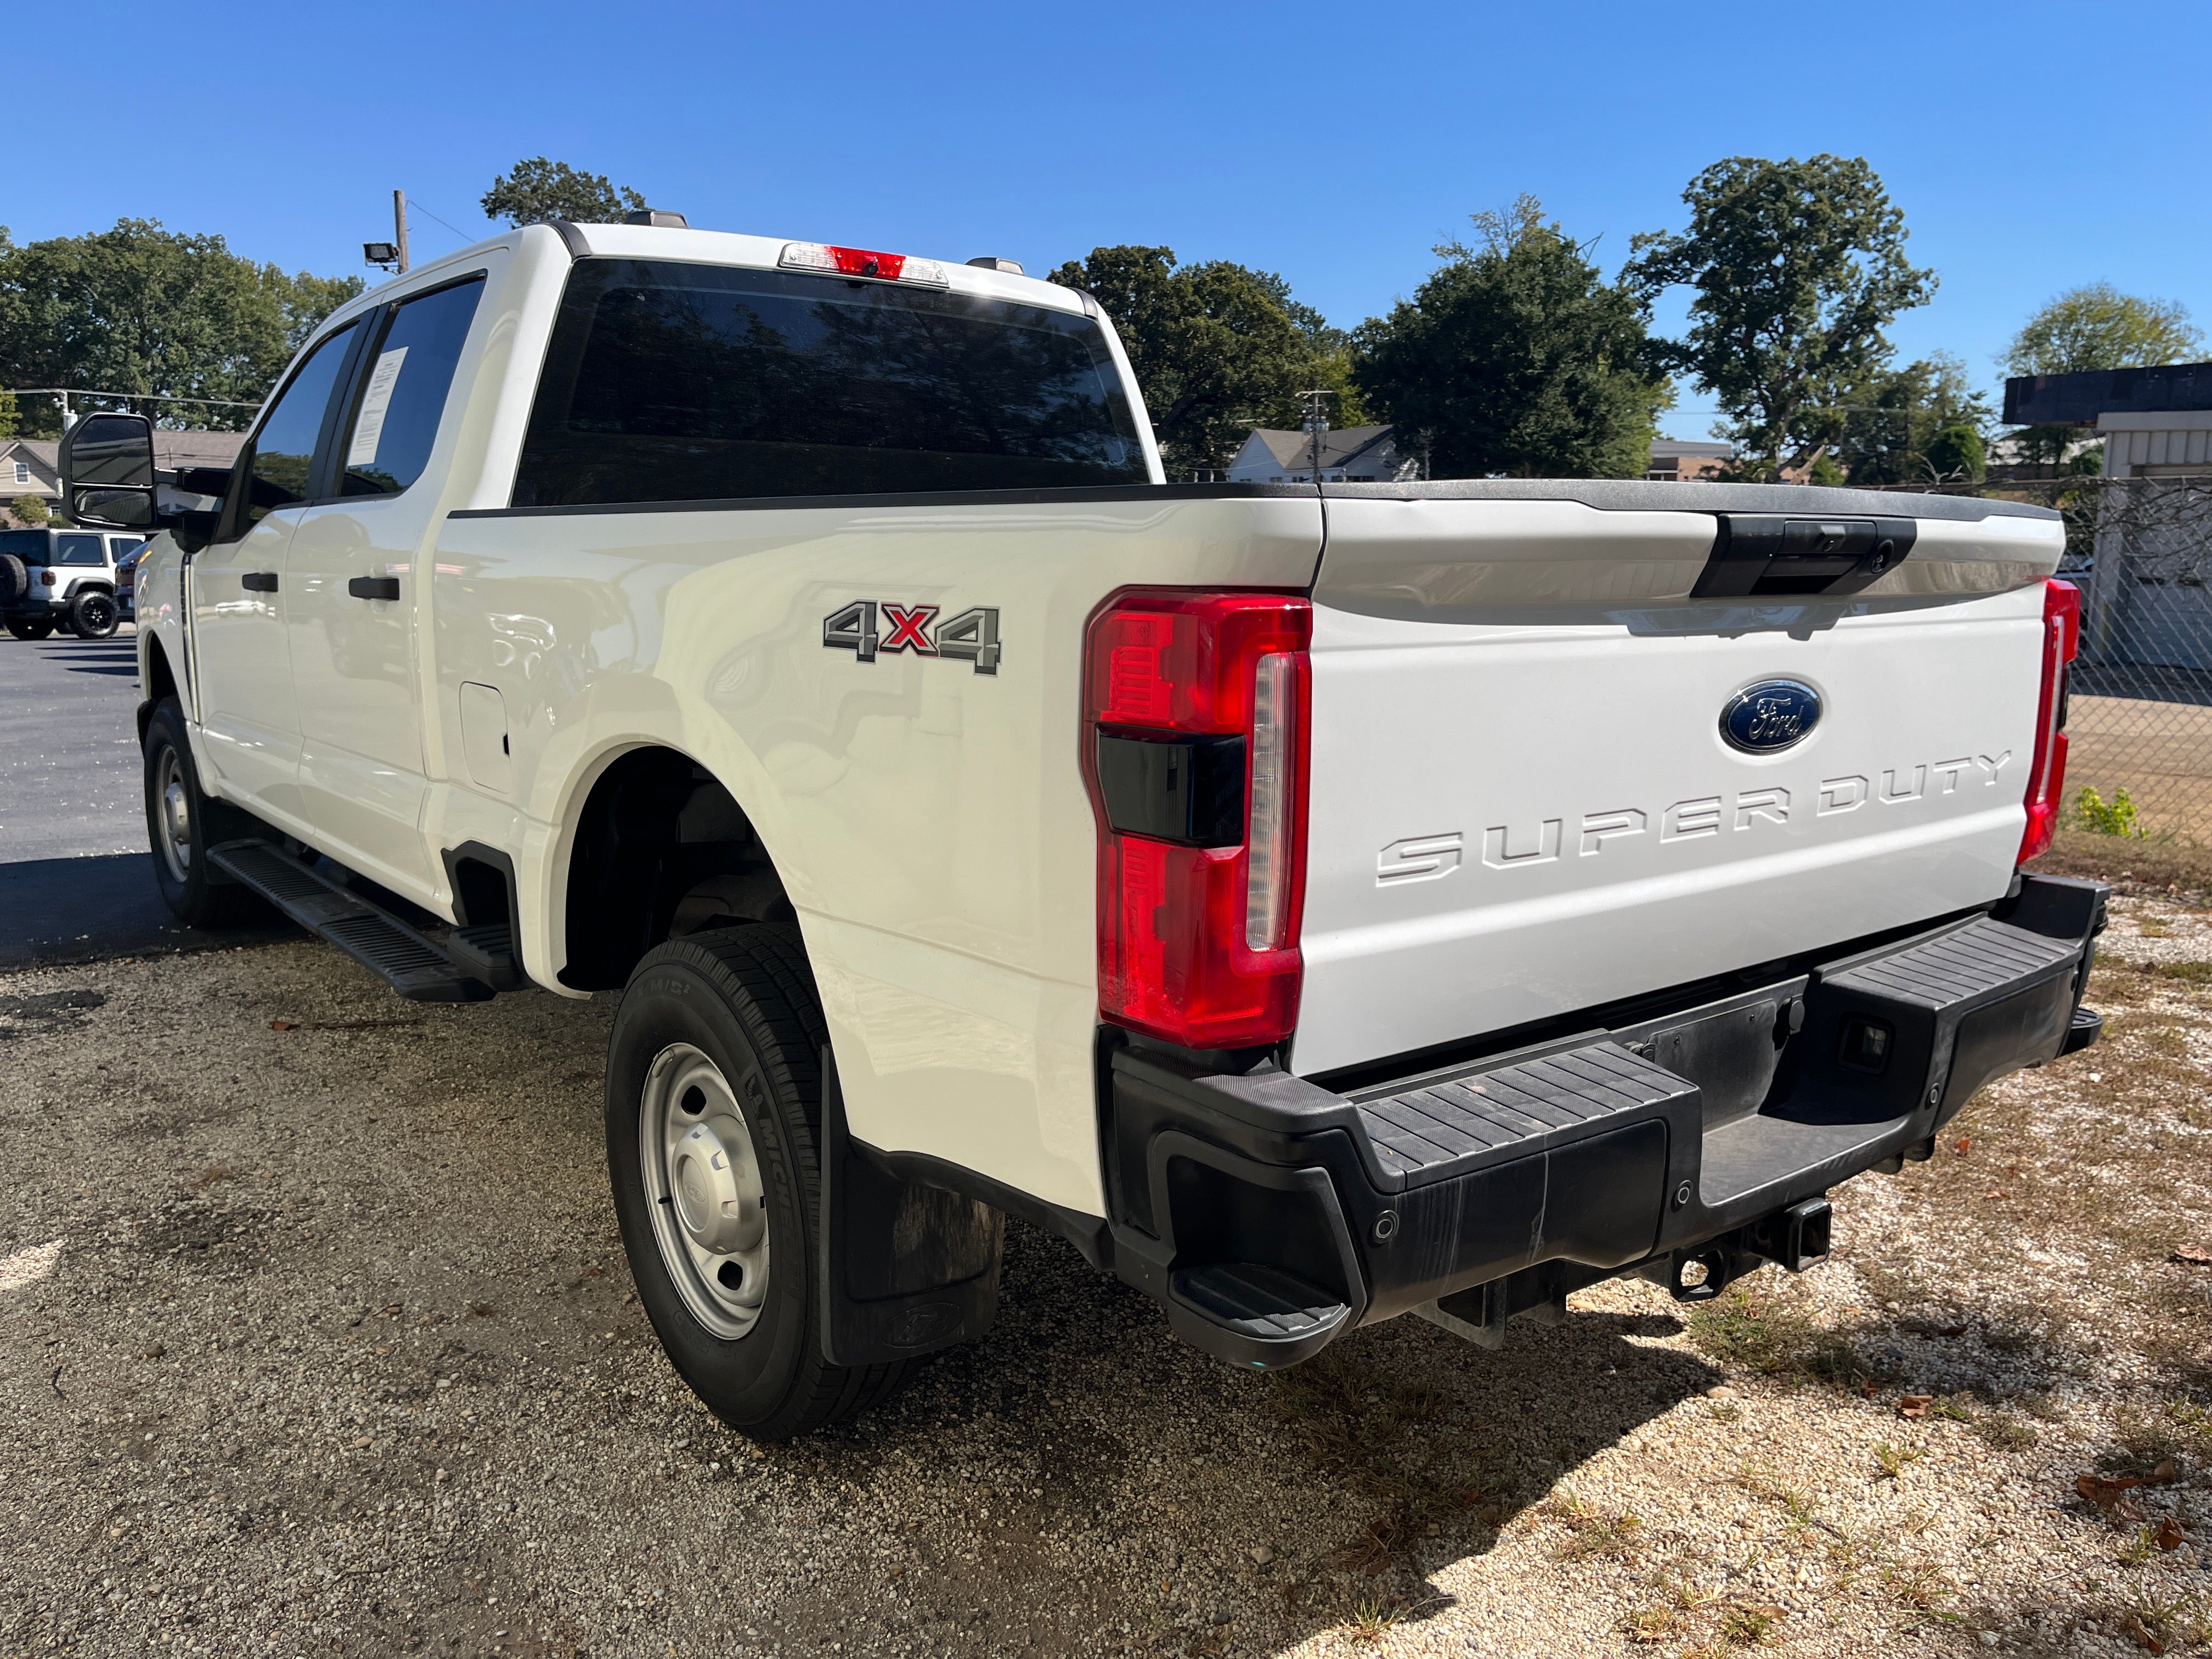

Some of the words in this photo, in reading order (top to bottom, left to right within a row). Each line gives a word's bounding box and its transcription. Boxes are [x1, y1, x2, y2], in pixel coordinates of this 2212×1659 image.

[1748, 697, 1804, 740] Ford
[1375, 786, 1791, 888] SUPER
[1816, 749, 2012, 817] DUTY
